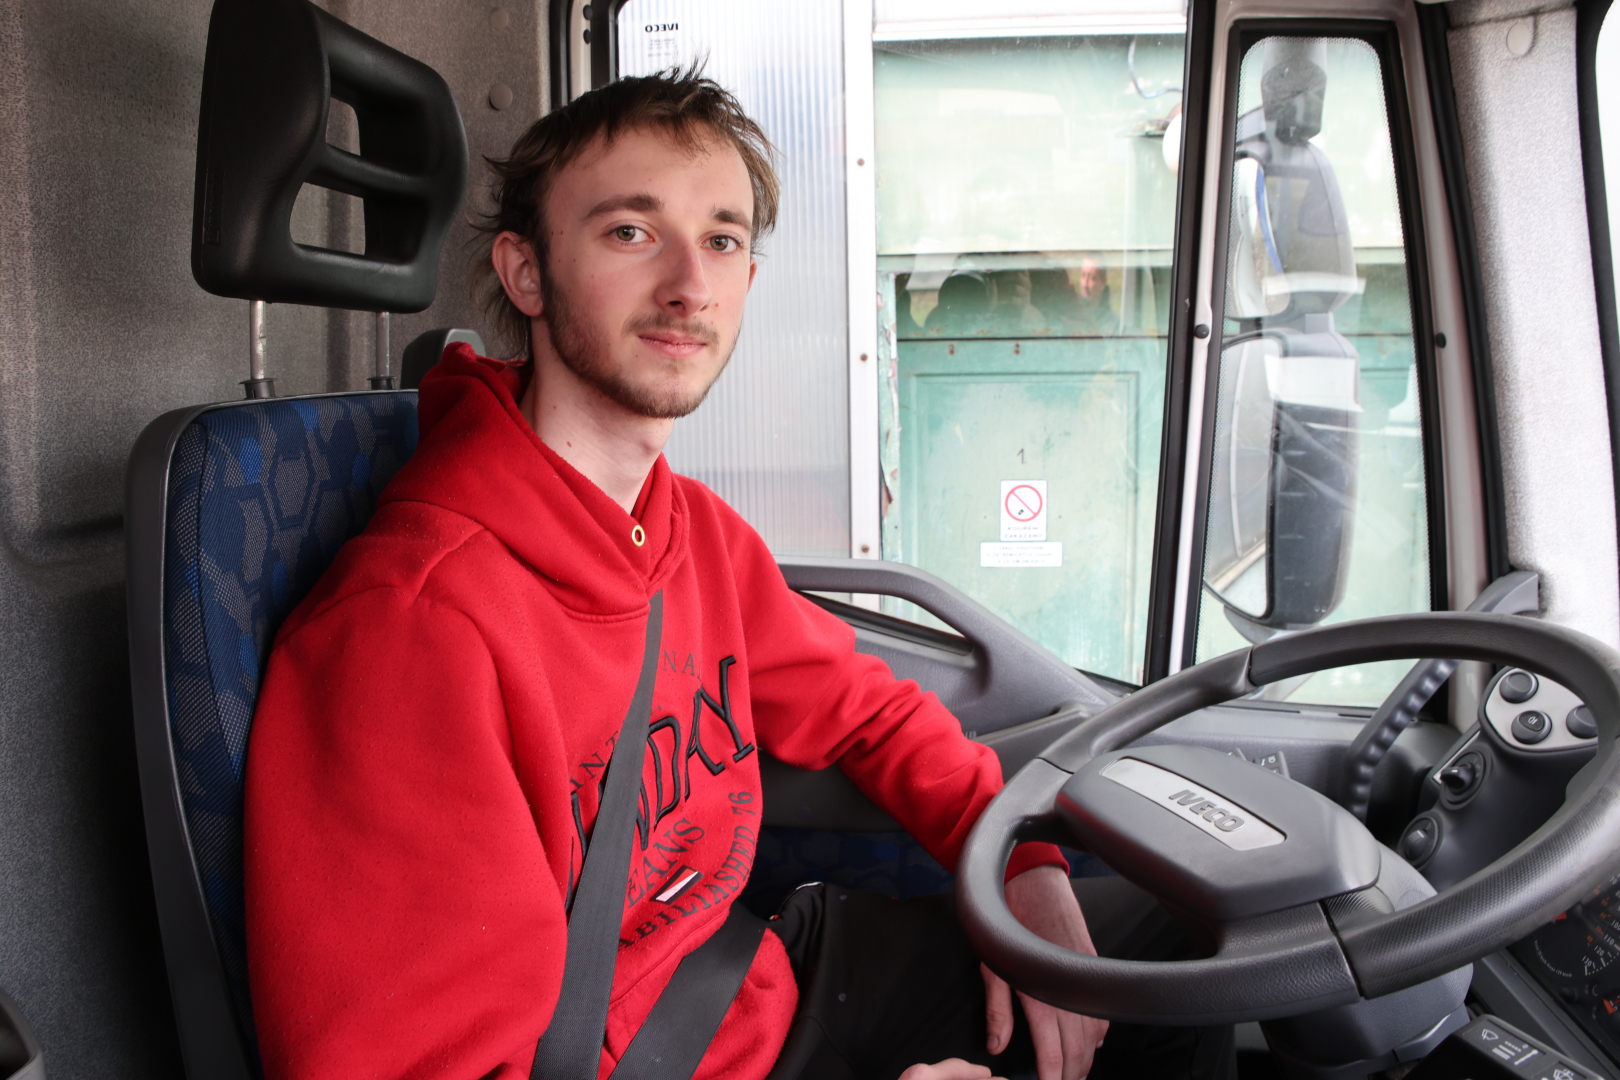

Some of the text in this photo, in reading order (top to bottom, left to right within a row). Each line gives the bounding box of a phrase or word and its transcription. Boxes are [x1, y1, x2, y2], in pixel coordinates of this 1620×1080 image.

[1016, 447, 1026, 465] 1
[1168, 789, 1245, 833] IVECO
[626, 817, 705, 908] EANS
[1604, 934, 1615, 946] 110
[1594, 945, 1605, 956] 120
[1582, 955, 1592, 967] 130
